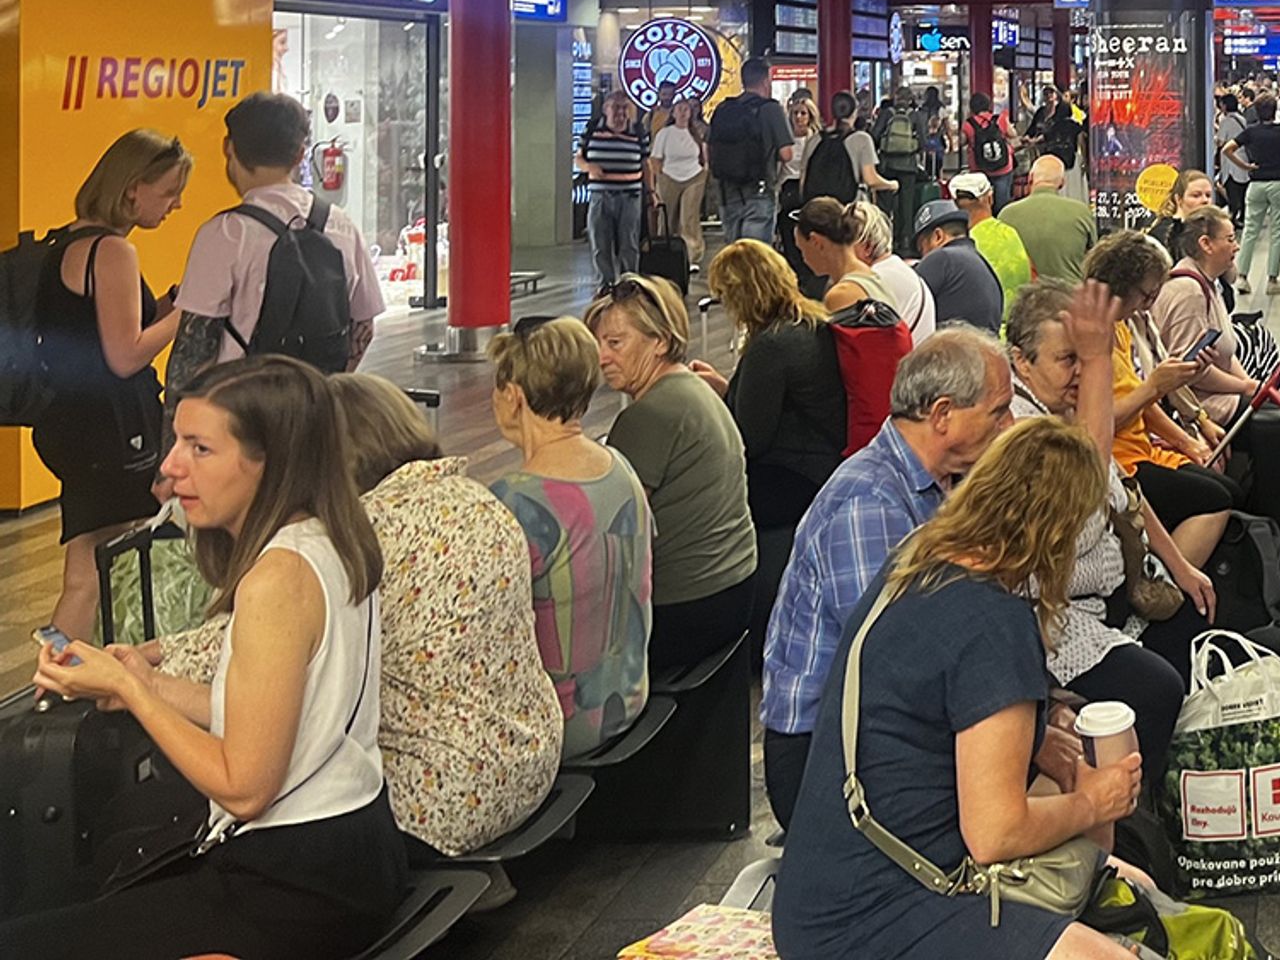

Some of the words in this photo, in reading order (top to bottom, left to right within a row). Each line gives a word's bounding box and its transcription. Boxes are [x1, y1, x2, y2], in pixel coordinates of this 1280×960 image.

[634, 23, 700, 51] COSTA
[96, 56, 245, 108] REGIOJET
[1177, 855, 1247, 872] Opakovane
[1192, 876, 1213, 888] pre
[1216, 871, 1256, 888] dobro
